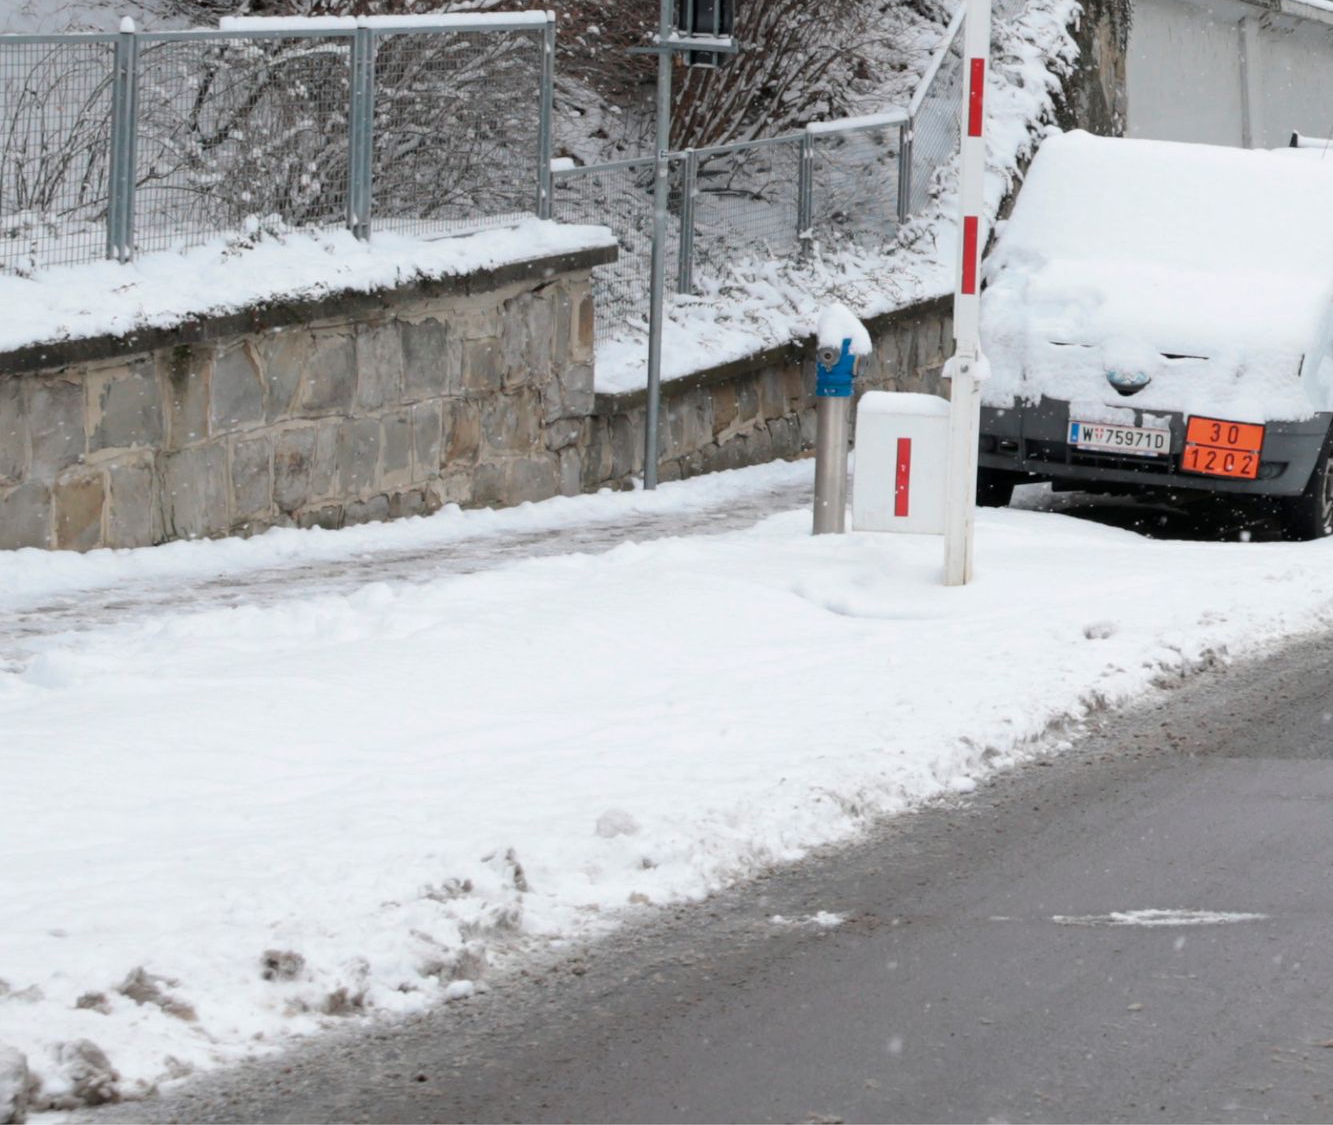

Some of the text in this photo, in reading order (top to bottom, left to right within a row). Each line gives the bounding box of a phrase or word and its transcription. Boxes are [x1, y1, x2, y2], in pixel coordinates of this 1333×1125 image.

[1083, 427, 1164, 449] W 75971D
[1210, 423, 1239, 445] 30
[1191, 449, 1253, 475] 1202
